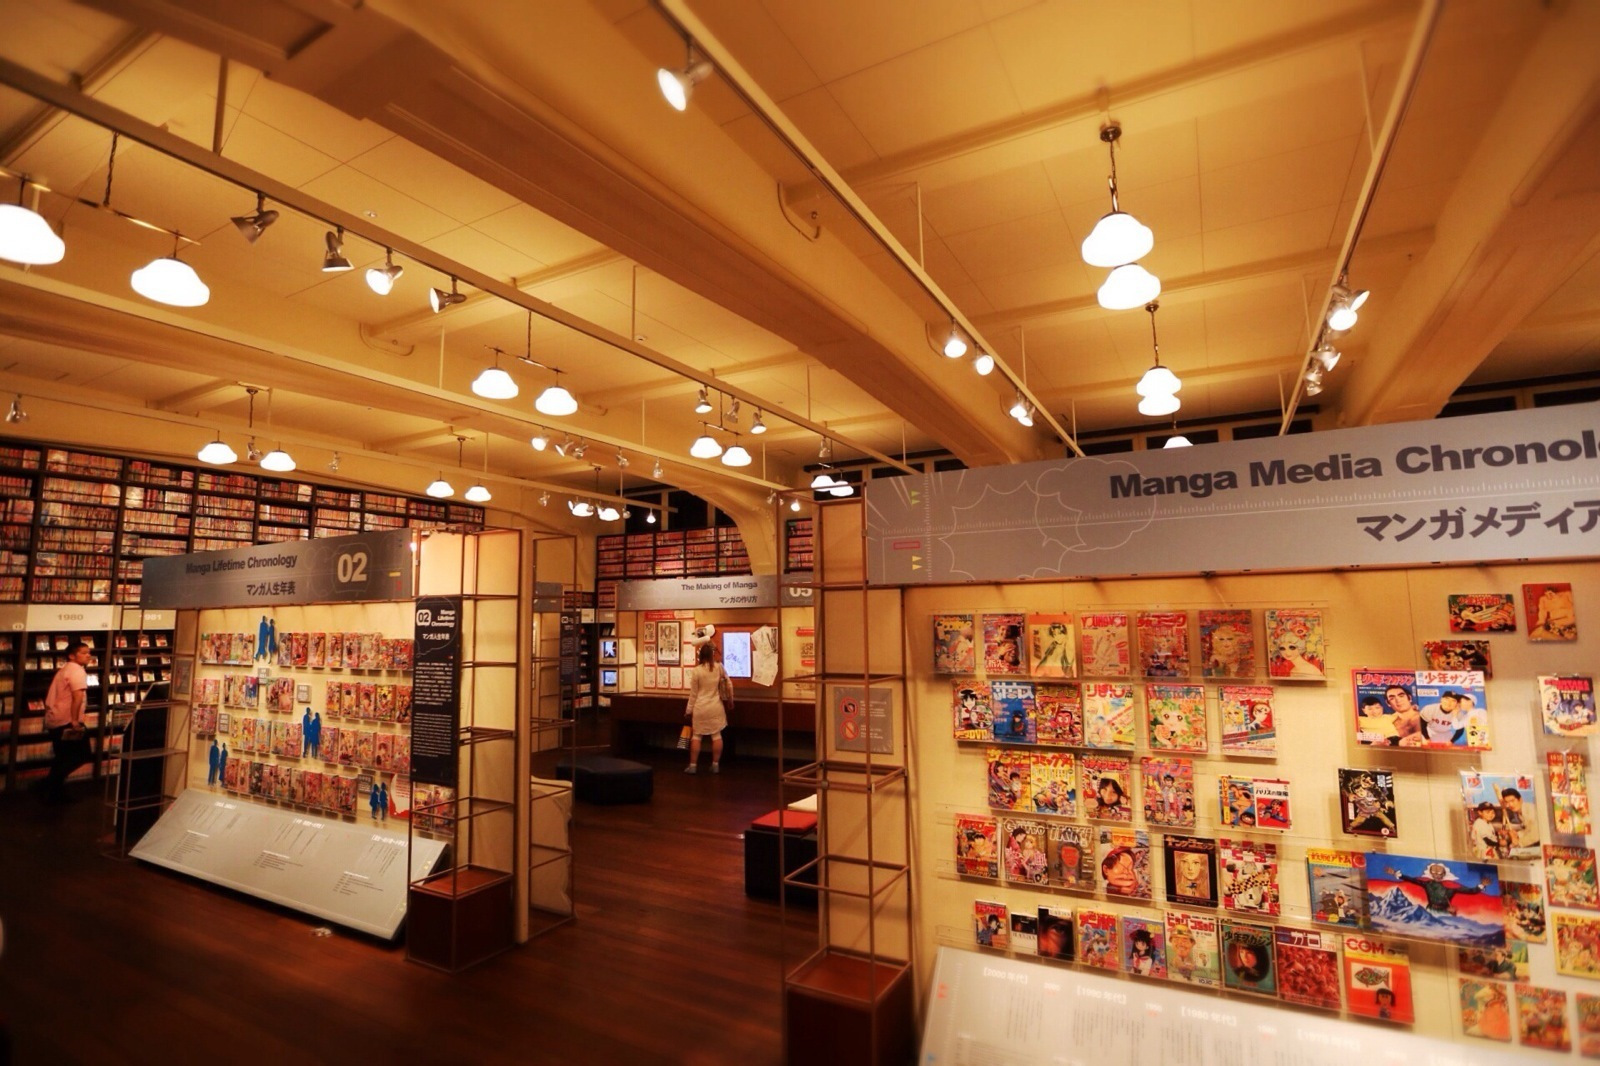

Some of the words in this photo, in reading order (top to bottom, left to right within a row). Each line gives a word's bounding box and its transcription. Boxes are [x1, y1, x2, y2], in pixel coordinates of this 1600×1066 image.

[1110, 469, 1238, 499] Manga
[1250, 453, 1382, 487] Media
[1396, 430, 1600, 474] Chronol
[186, 561, 211, 575] Manga
[212, 558, 246, 572] Lifetime
[247, 554, 298, 570] Chronology
[337, 552, 367, 583] 02
[696, 582, 722, 591] Making
[732, 581, 758, 589] Manga
[57, 613, 84, 621] 1980
[418, 612, 430, 623] 02
[1424, 671, 1482, 685] 少年サンデー
[1290, 931, 1321, 949] ガロ
[1345, 938, 1385, 955] COM
